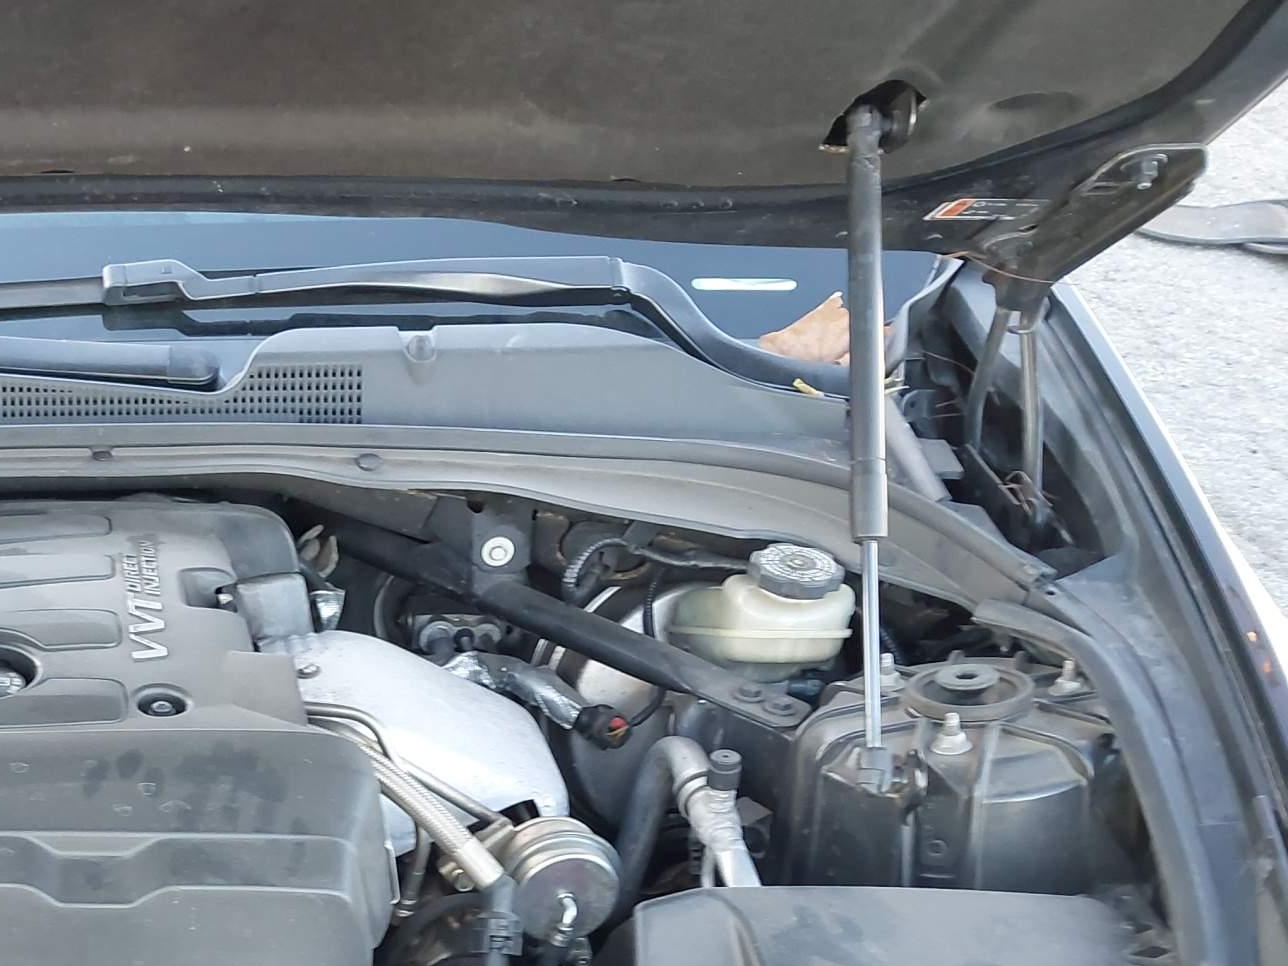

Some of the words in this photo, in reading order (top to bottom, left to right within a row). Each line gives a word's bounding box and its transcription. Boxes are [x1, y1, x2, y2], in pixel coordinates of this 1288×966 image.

[122, 553, 141, 593] DIRECT
[139, 539, 160, 596] INJECTION
[127, 591, 169, 660] VVT
